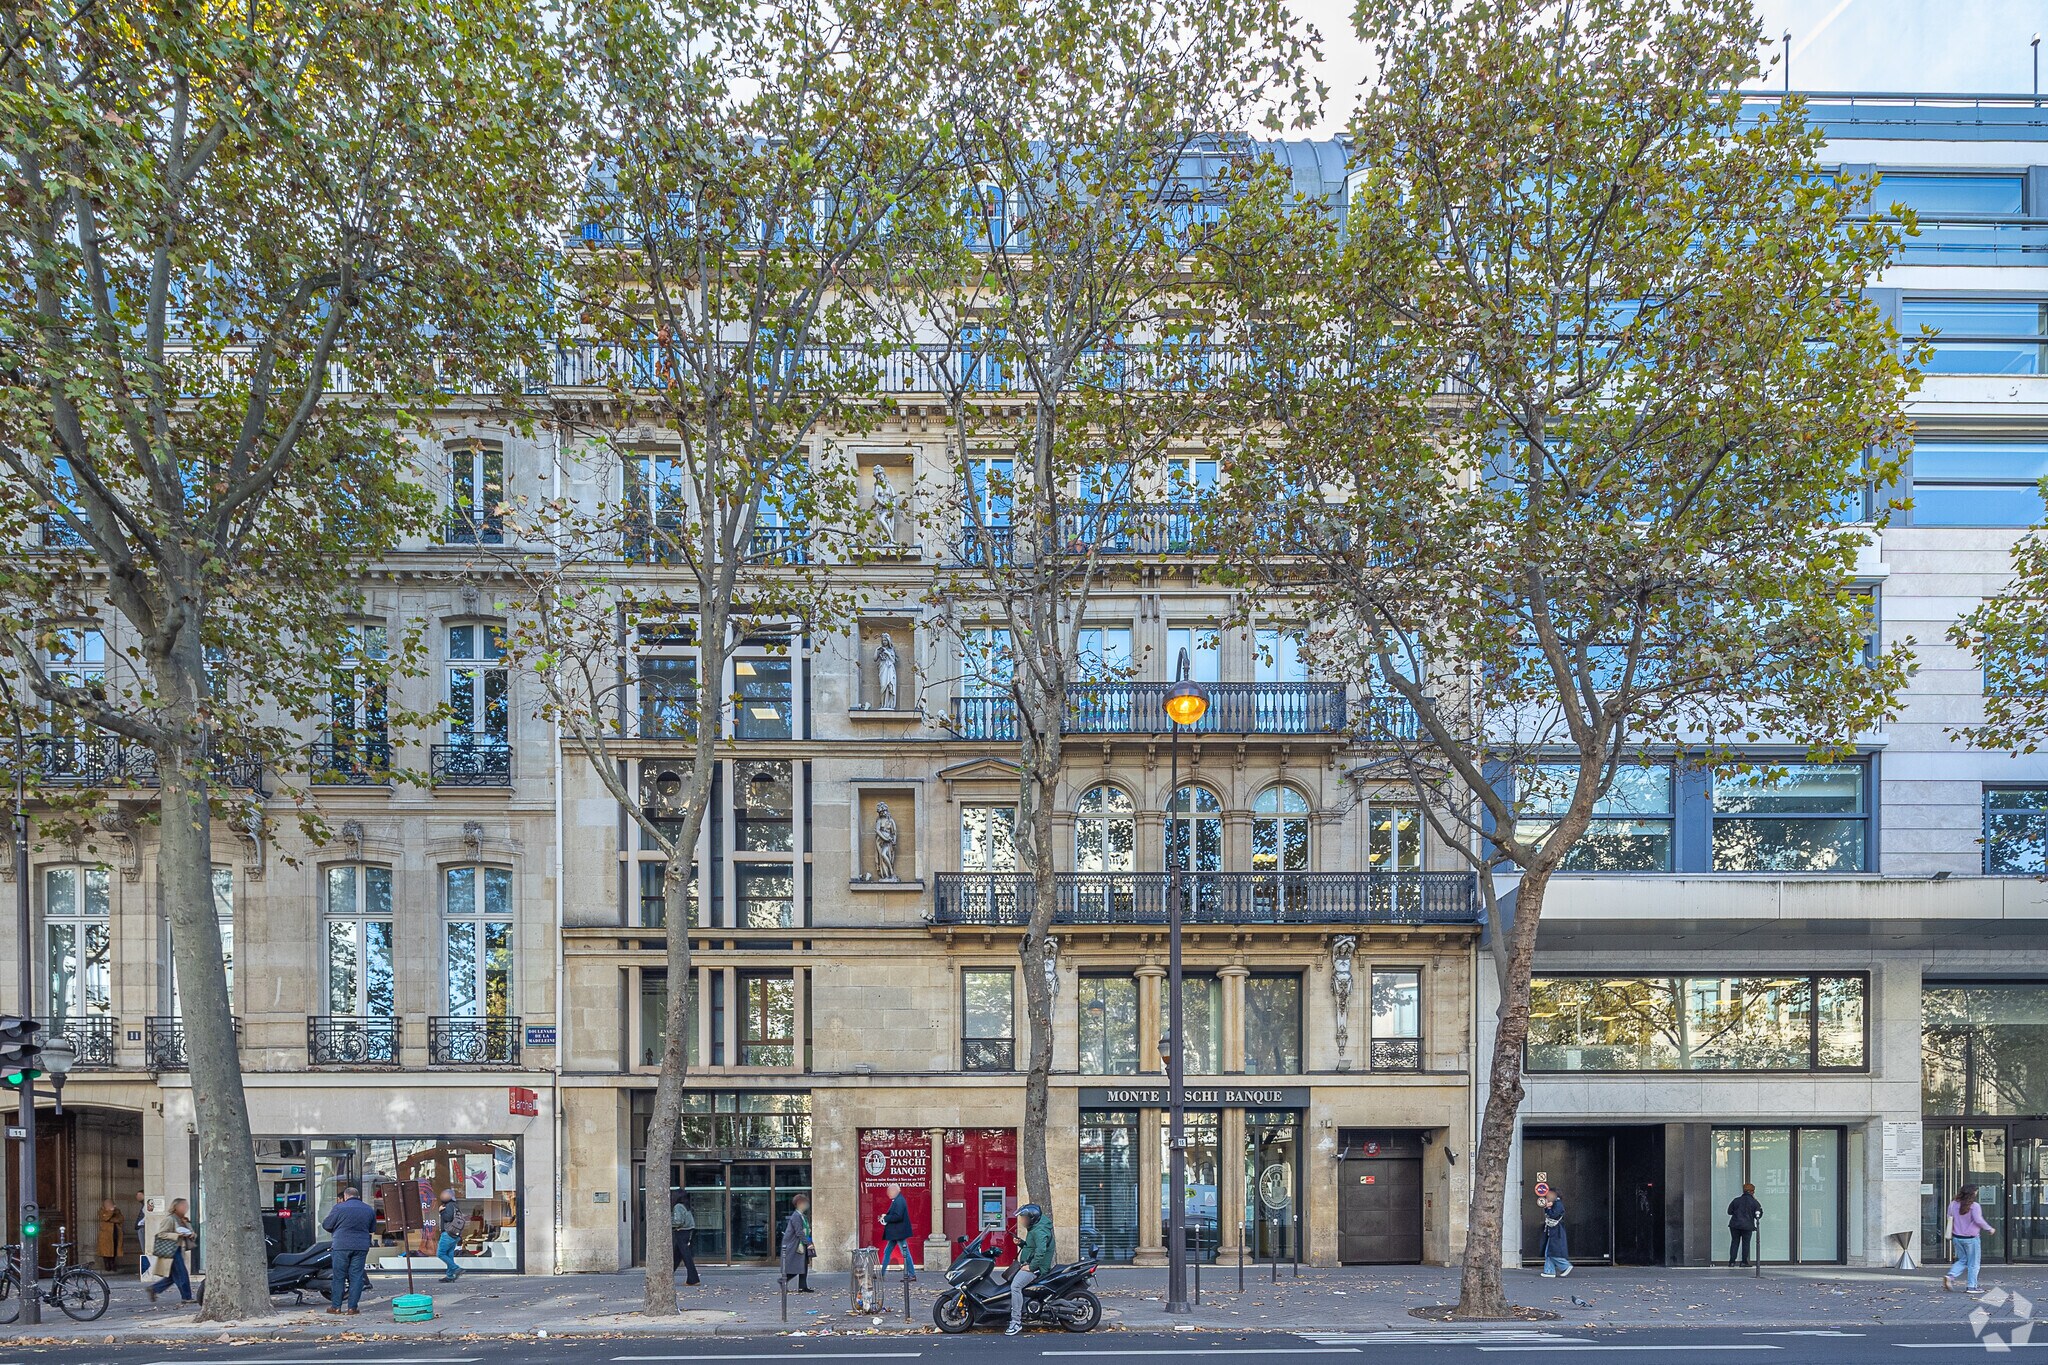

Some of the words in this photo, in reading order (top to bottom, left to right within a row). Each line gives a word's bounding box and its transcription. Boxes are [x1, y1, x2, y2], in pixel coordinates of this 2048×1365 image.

[130, 1032, 139, 1040] 11
[1107, 1090, 1160, 1102] MONTE
[1225, 1090, 1283, 1104] BANQUE
[515, 1100, 533, 1112] arche
[890, 1149, 926, 1157] MONTE
[890, 1158, 926, 1166] PASCHI
[890, 1167, 926, 1176] BANQUE
